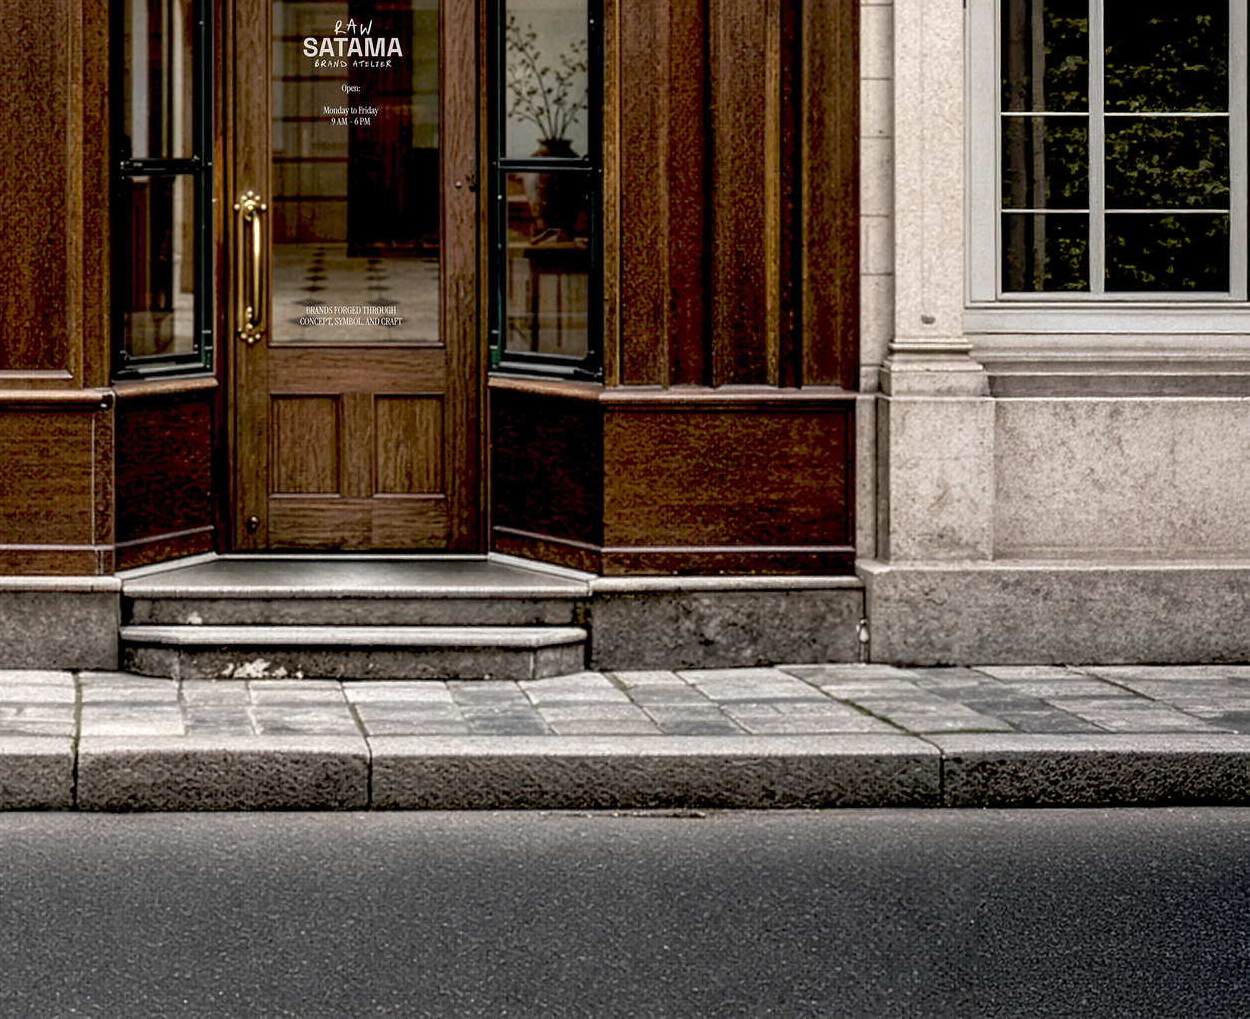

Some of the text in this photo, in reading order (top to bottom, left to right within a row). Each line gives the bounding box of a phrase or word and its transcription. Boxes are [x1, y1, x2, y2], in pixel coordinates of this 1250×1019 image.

[334, 18, 373, 36] RAW
[303, 37, 403, 57] SATAMA
[314, 59, 392, 68] BRAND ATELIER
[341, 83, 361, 94] Open:
[323, 105, 379, 116] Monday to Friday
[331, 117, 336, 125] 9
[336, 117, 348, 125] AM
[354, 117, 359, 125] 6
[359, 117, 371, 125] PM
[305, 306, 397, 315] BRANDS FORGED THROUGH
[299, 317, 403, 326] CONCEPT, SYMBOL, AND CRAFT
